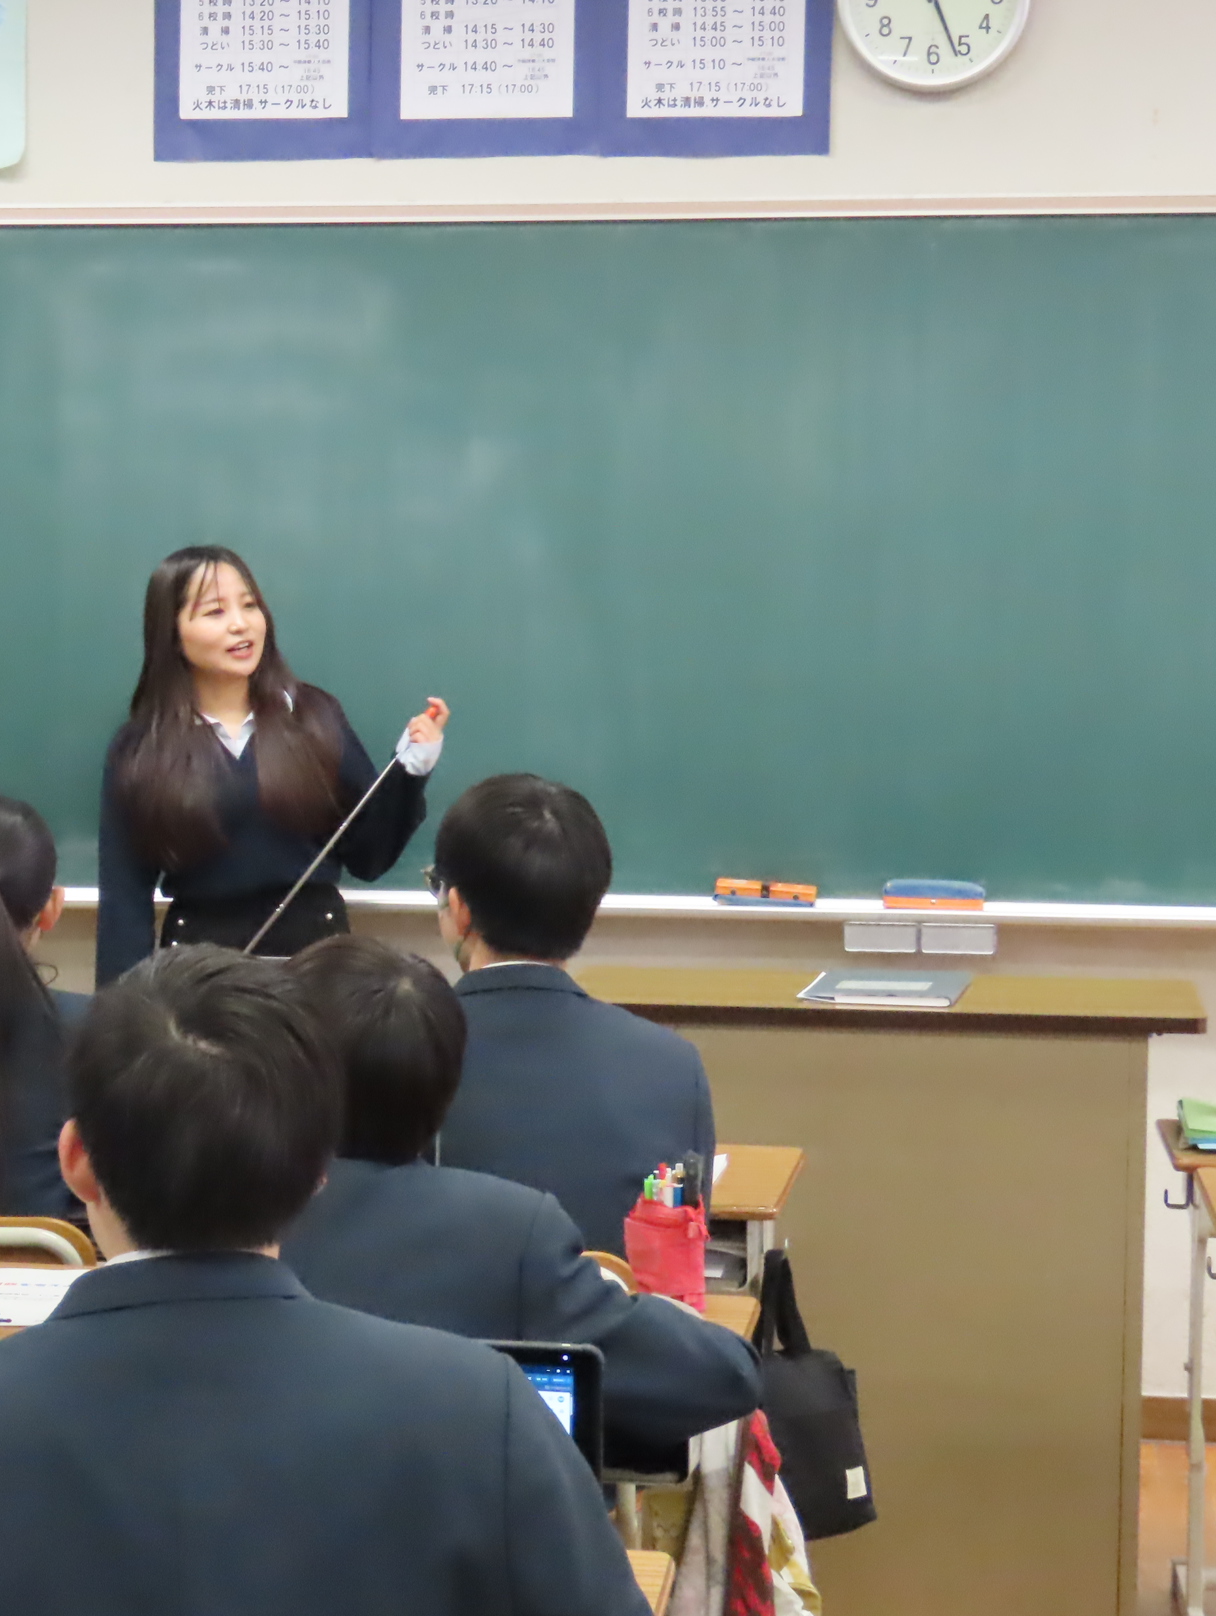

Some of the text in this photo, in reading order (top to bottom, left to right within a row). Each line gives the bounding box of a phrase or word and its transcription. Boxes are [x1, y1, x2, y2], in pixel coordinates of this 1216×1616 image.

[879, 16, 892, 37] 8
[978, 13, 991, 34] 4
[200, 41, 230, 50] つどい
[422, 40, 452, 50] つどい
[649, 38, 680, 47] つどい
[900, 36, 913, 57] 7
[957, 35, 970, 56] 5
[927, 44, 940, 65] 6
[194, 63, 234, 72] サークル
[416, 62, 457, 72] サークル
[644, 60, 685, 69] サークル
